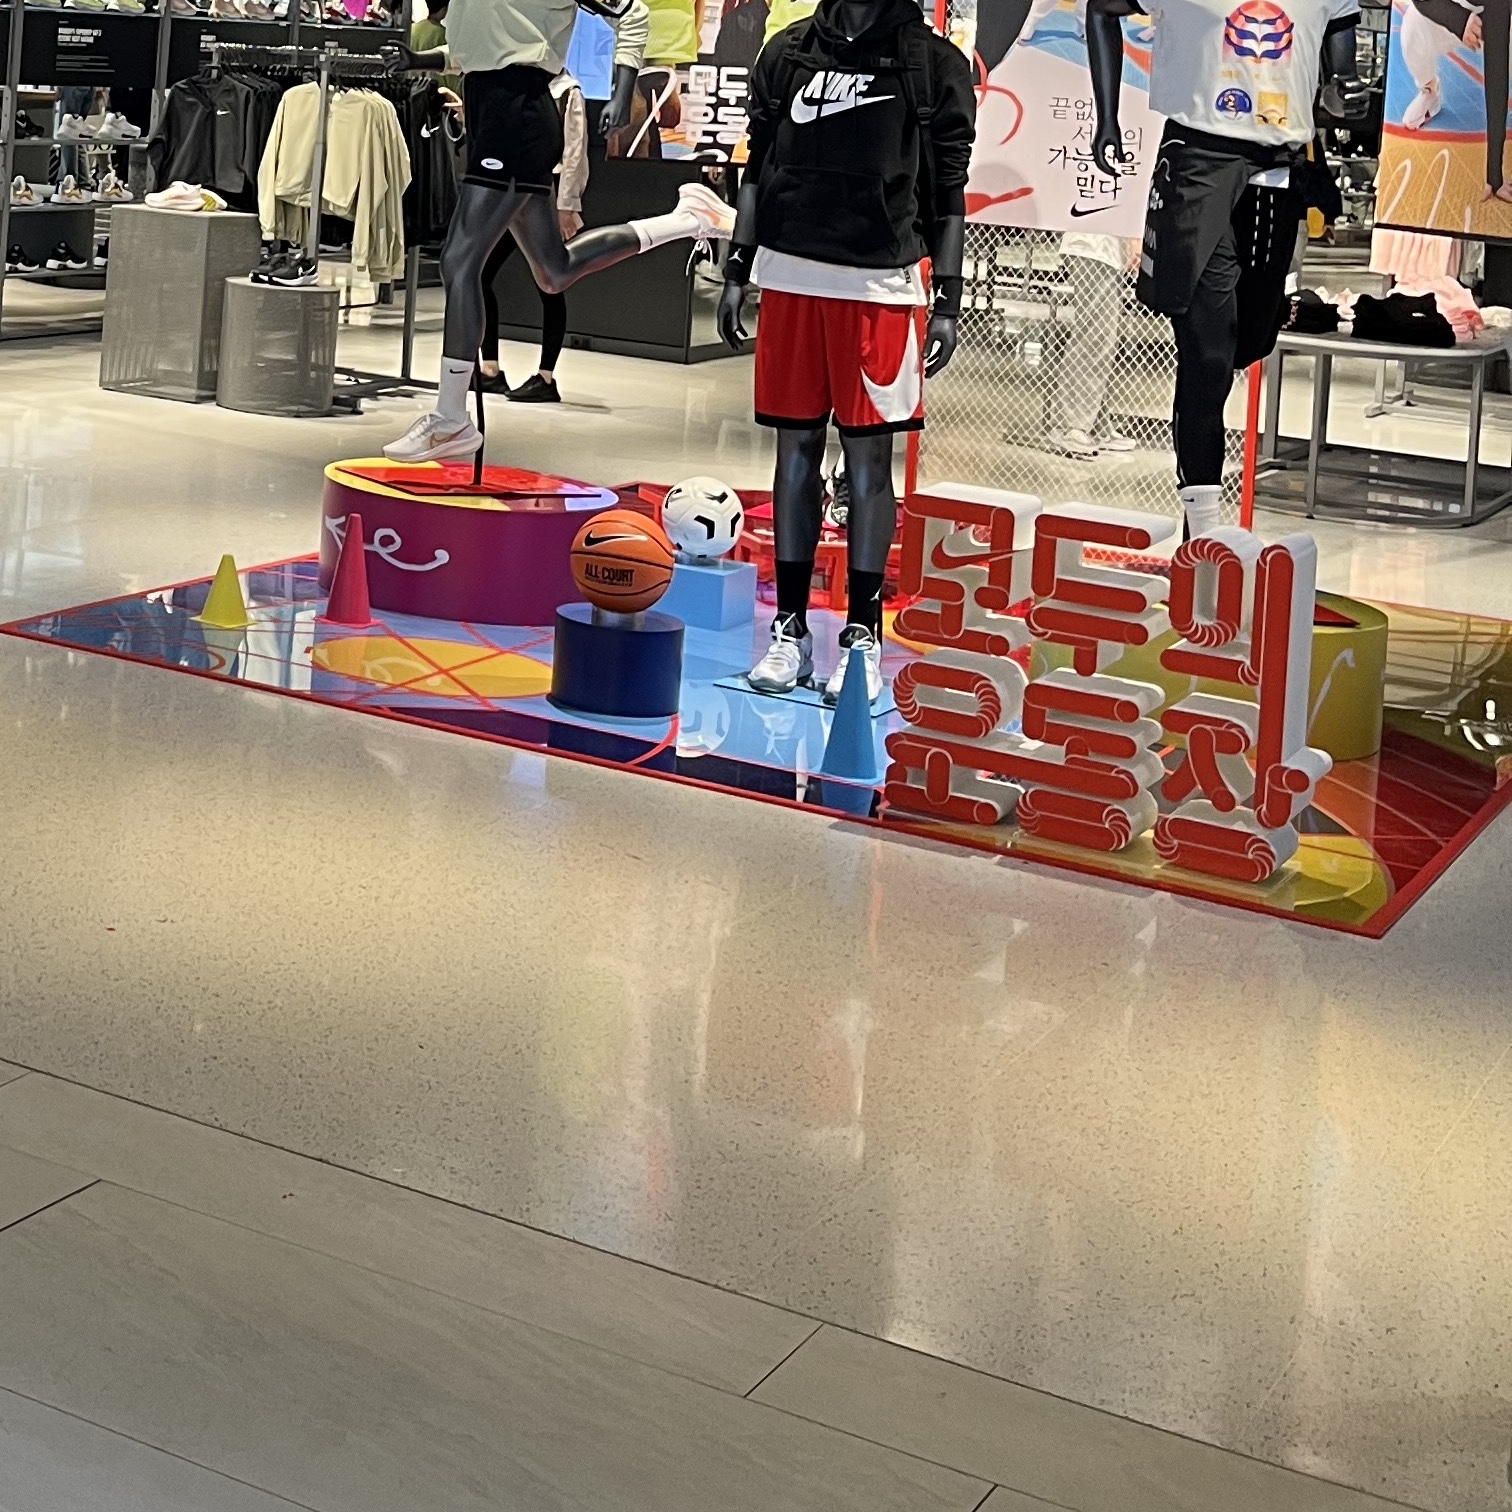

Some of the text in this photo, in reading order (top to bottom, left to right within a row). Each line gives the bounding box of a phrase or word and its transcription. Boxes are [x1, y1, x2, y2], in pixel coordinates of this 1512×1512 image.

[803, 70, 876, 106] NIKE
[1048, 96, 1096, 122] 끝없
[1071, 123, 1143, 152] 서의
[1048, 145, 1142, 176] 가능을
[1076, 174, 1123, 201] 믿다
[601, 566, 635, 584] COURT
[891, 484, 1303, 690] 모두의
[884, 650, 1314, 883] 운동장
